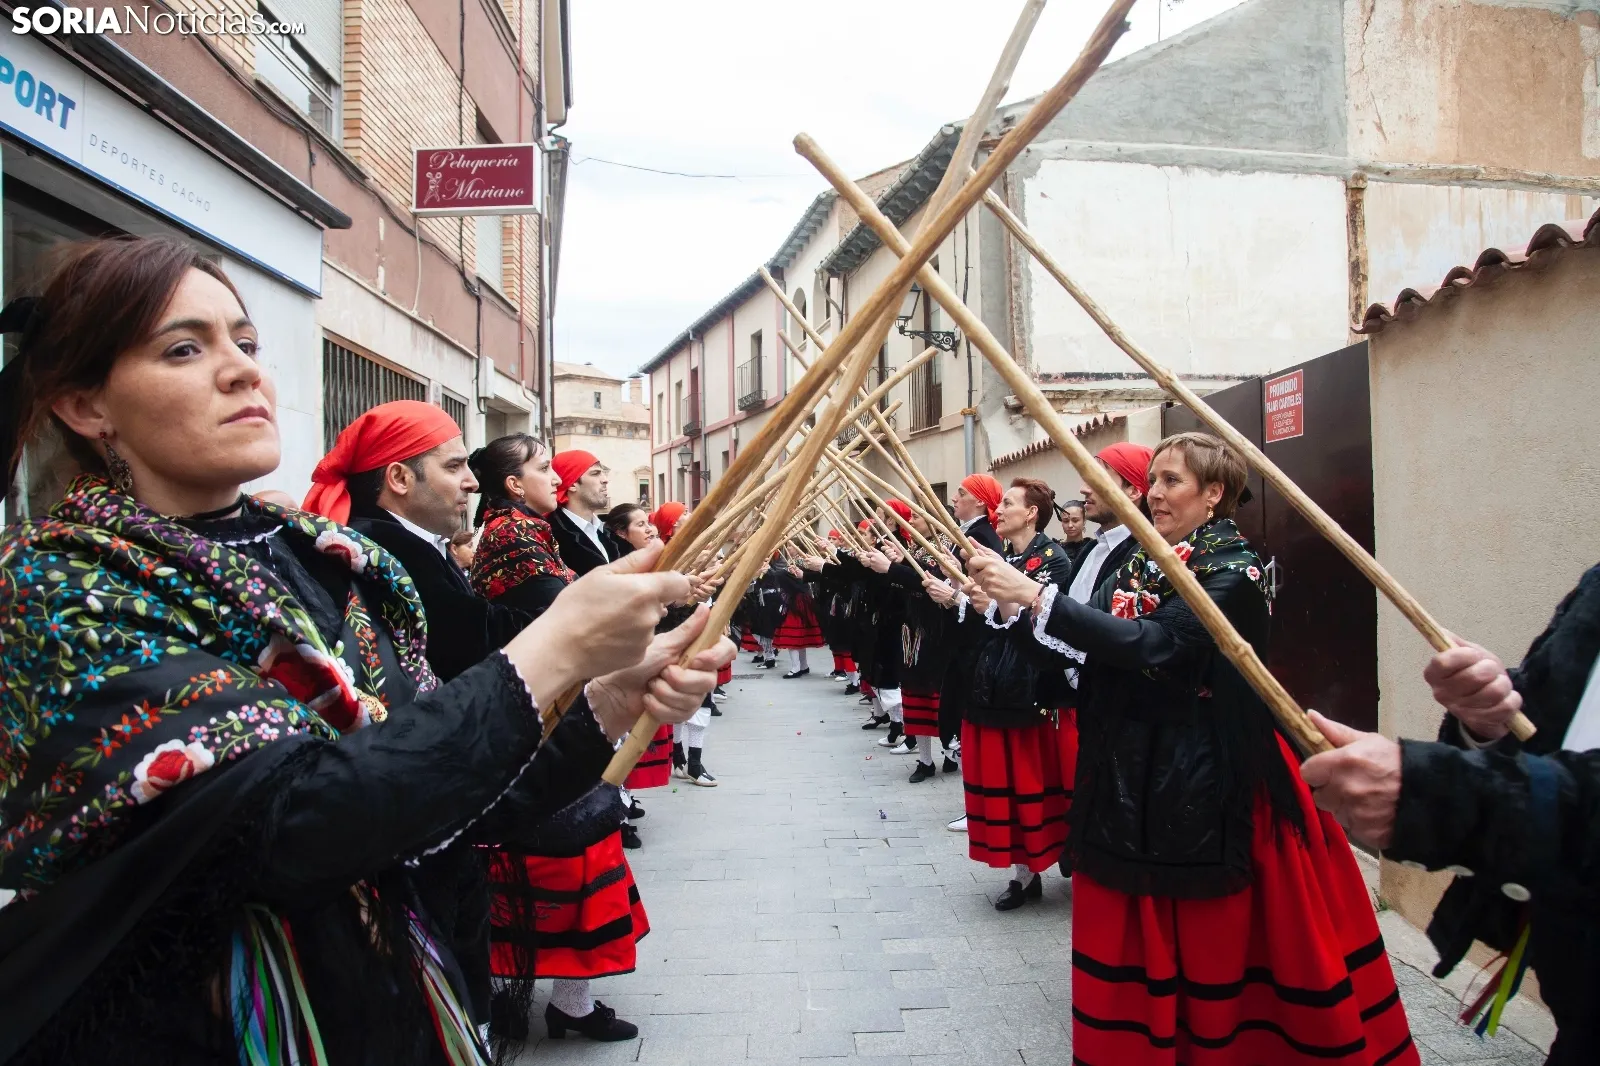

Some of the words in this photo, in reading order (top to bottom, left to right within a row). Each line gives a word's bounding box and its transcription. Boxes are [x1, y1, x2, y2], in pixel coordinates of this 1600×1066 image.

[89, 133, 165, 186] DEPORTES
[171, 182, 211, 212] CACHO
[429, 150, 519, 175] Peluquería
[441, 177, 525, 200] Mariano
[1269, 377, 1298, 398] PROHIBIDO
